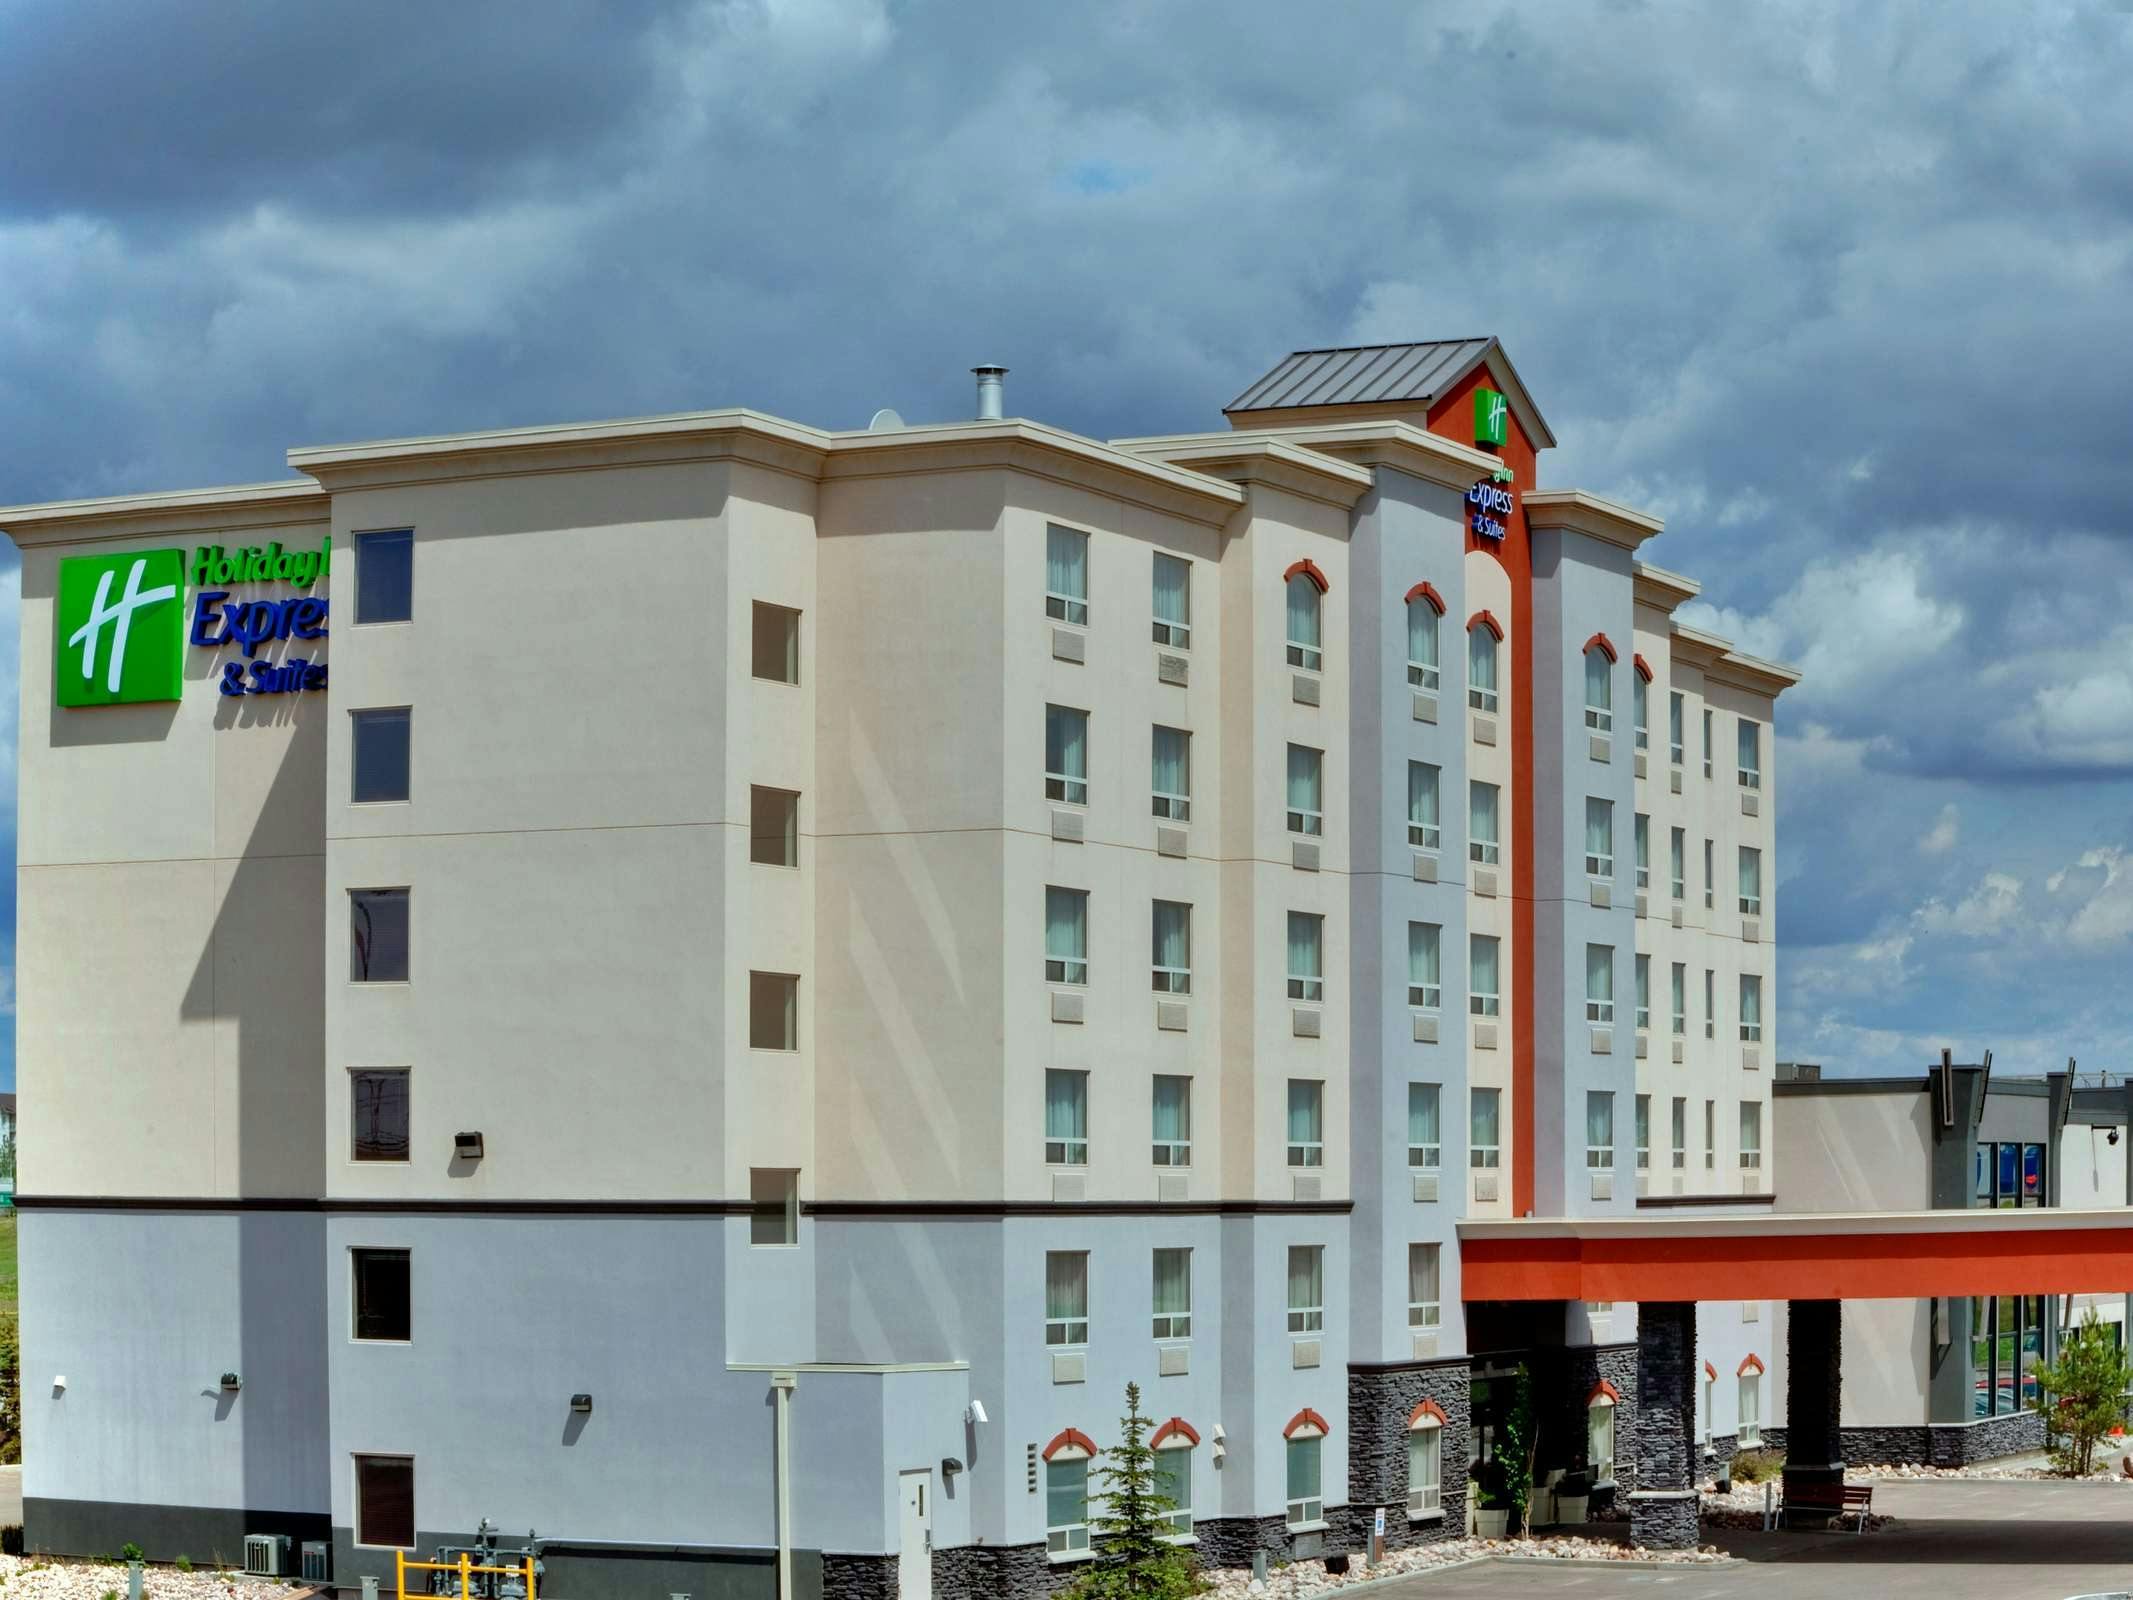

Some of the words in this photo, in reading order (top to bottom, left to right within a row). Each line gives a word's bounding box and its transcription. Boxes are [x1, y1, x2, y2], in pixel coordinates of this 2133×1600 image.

[1484, 517, 1506, 541] Suites
[191, 541, 321, 588] Holiday
[190, 592, 329, 658] Expre
[220, 662, 247, 696] &
